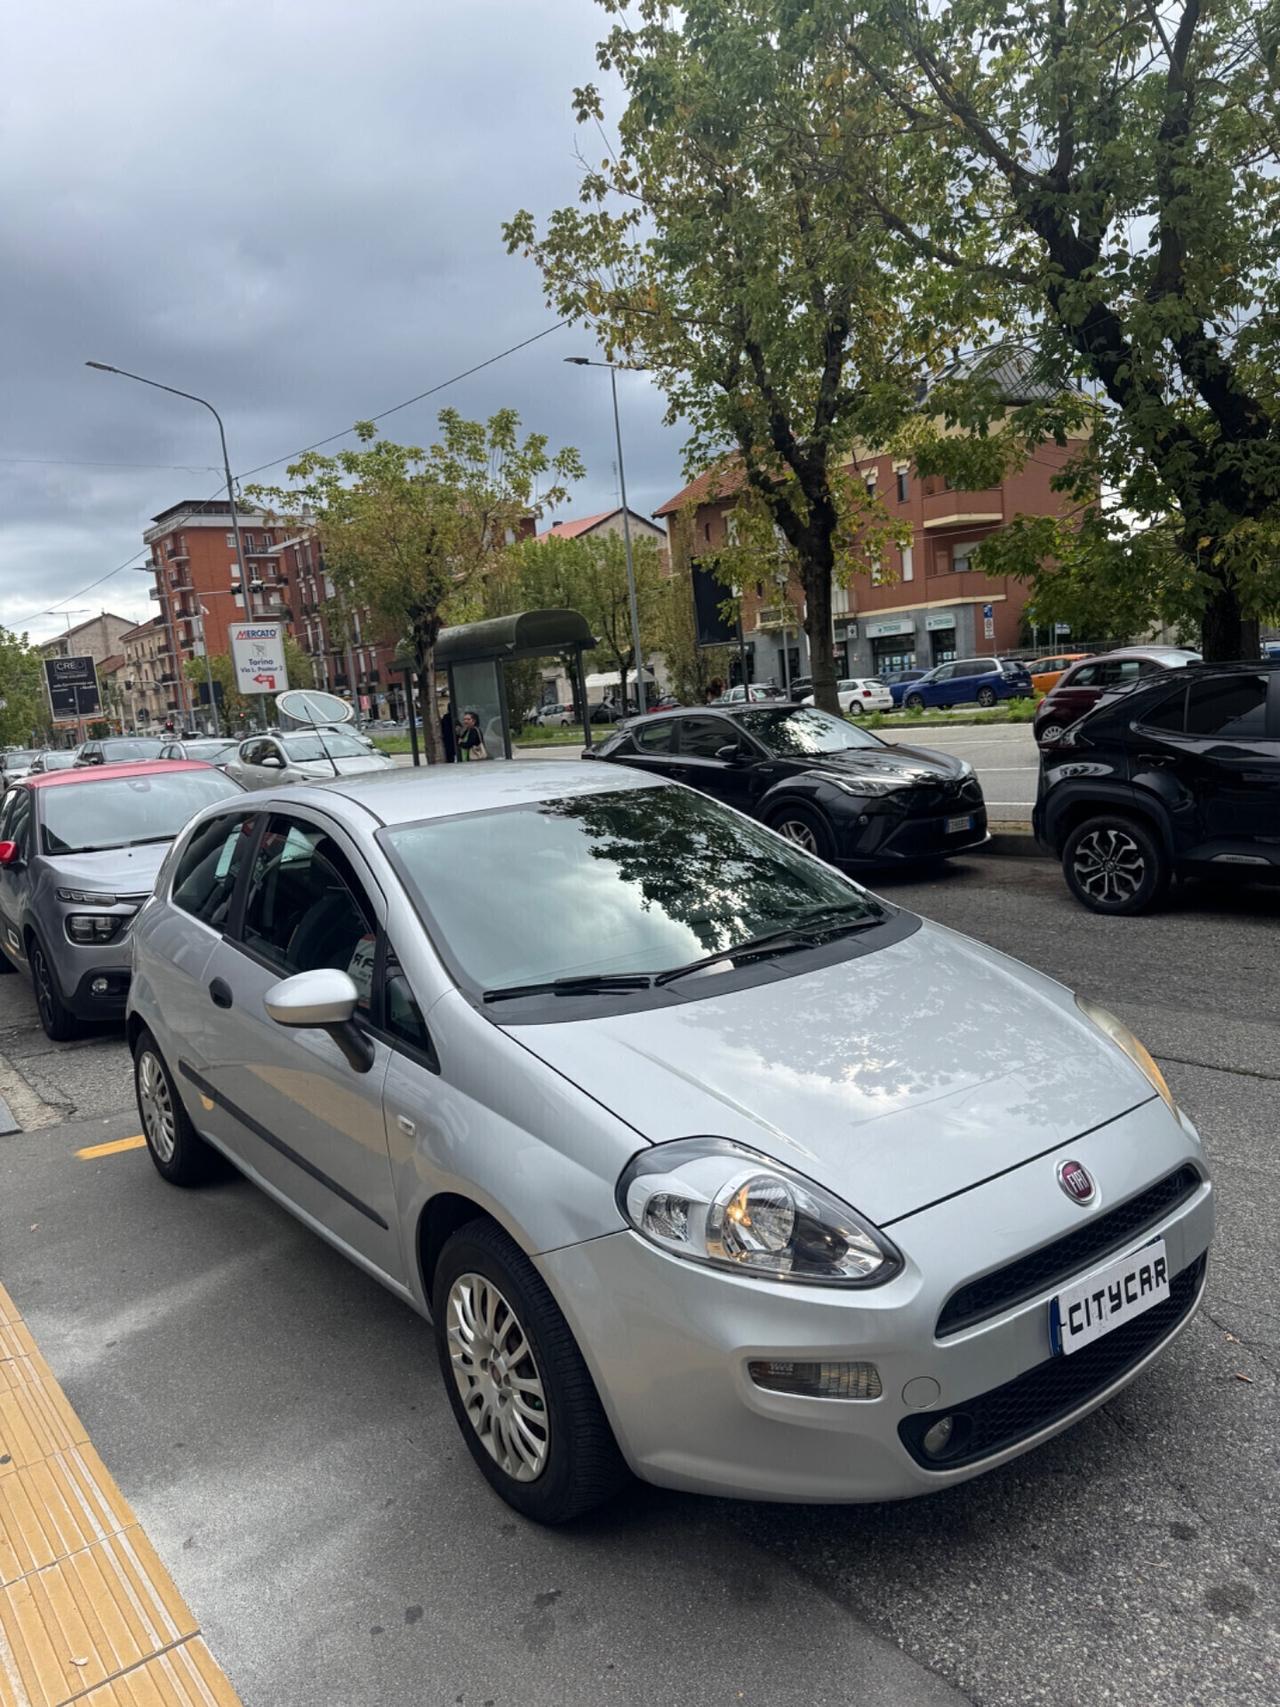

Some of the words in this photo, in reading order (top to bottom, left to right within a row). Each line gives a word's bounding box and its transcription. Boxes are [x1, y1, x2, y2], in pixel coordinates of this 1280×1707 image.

[248, 658, 273, 666] Torino
[1066, 1169, 1089, 1193] FIAT
[1068, 1256, 1167, 1336] CITYCAR
